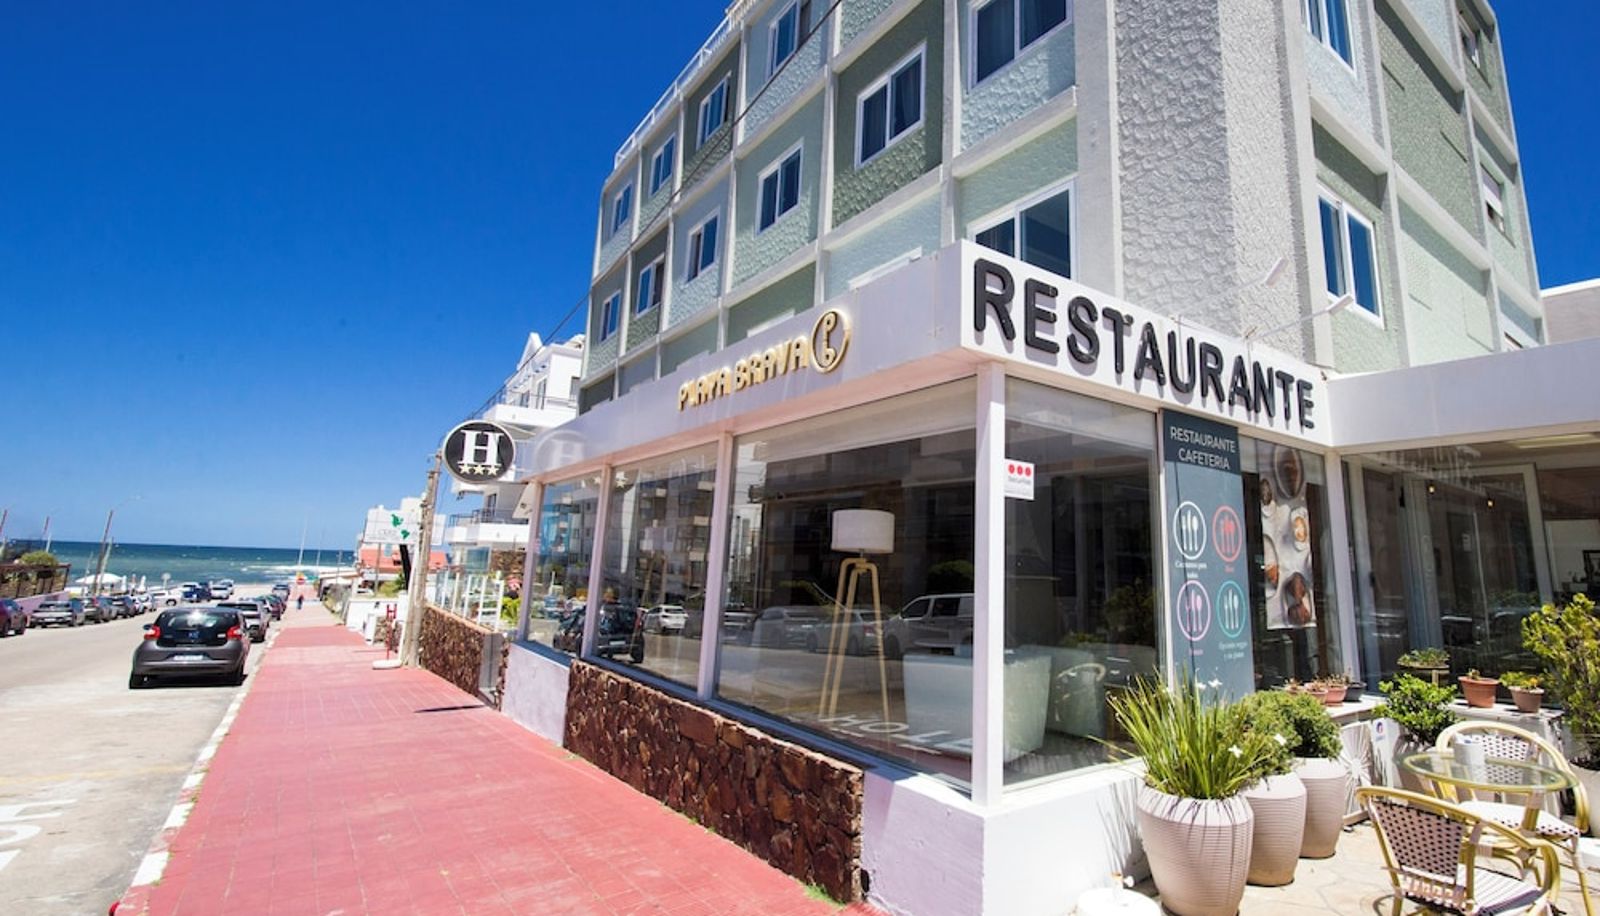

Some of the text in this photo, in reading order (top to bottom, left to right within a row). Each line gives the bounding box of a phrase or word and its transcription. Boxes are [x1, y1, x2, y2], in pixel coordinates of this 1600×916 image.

[974, 258, 1315, 430] RESTAURANTE
[678, 335, 809, 412] PLAYA BRAVA
[457, 429, 505, 466] H
[1170, 426, 1236, 453] RESTAURANTE
[1178, 448, 1230, 470] CAFETERIA
